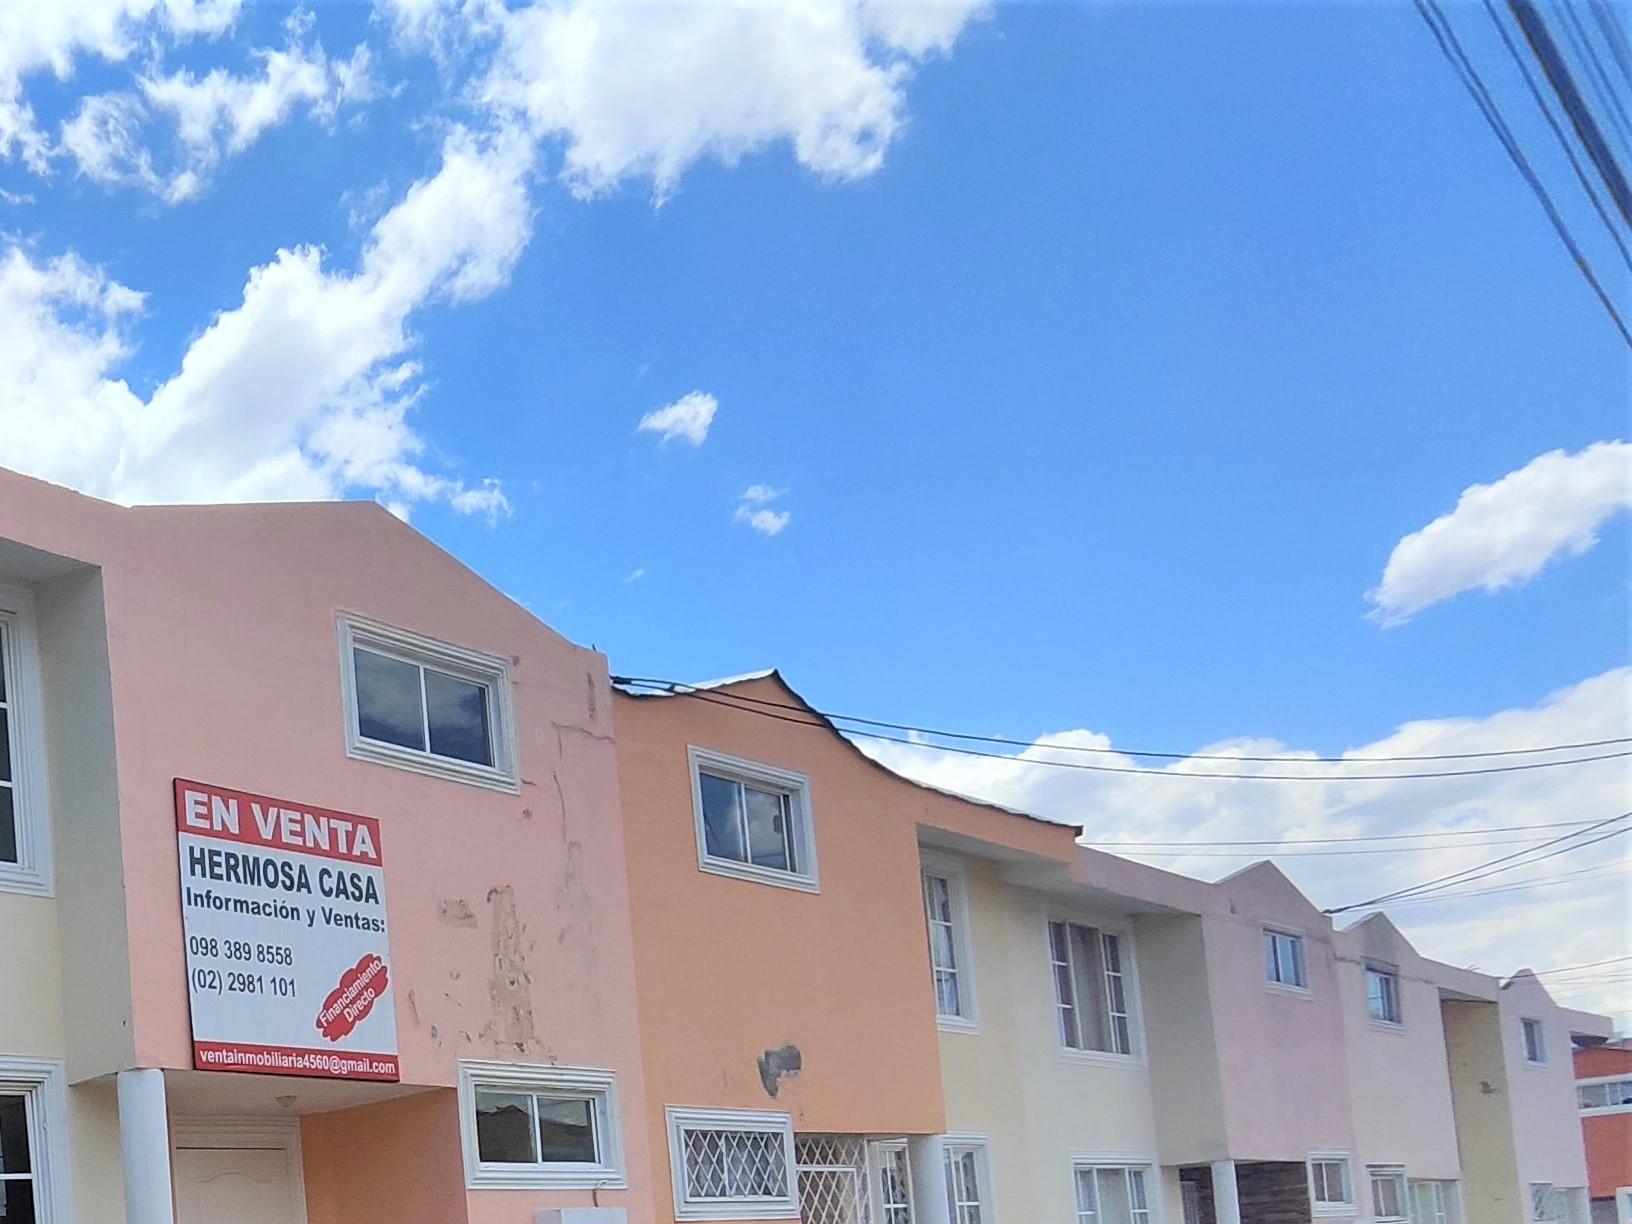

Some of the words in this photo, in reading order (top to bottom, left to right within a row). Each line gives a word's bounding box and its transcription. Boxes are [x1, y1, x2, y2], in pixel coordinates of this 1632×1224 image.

[184, 789, 240, 835] EN
[251, 803, 377, 859] VENTA
[188, 845, 313, 895] HERMOSA
[318, 867, 380, 905] CASA
[186, 886, 301, 921] Información
[305, 908, 316, 928] y
[321, 906, 386, 933] Ventas:
[189, 935, 219, 958] 098
[223, 939, 252, 962] 389
[256, 943, 293, 966] 8558
[191, 967, 223, 996] (02)
[227, 972, 264, 994] 2981
[269, 976, 297, 998] 101
[319, 958, 382, 1027] Financiamiento
[343, 987, 376, 1023] Directo
[199, 1048, 396, 1075] ventainmobiliaria4560@gmail.com
